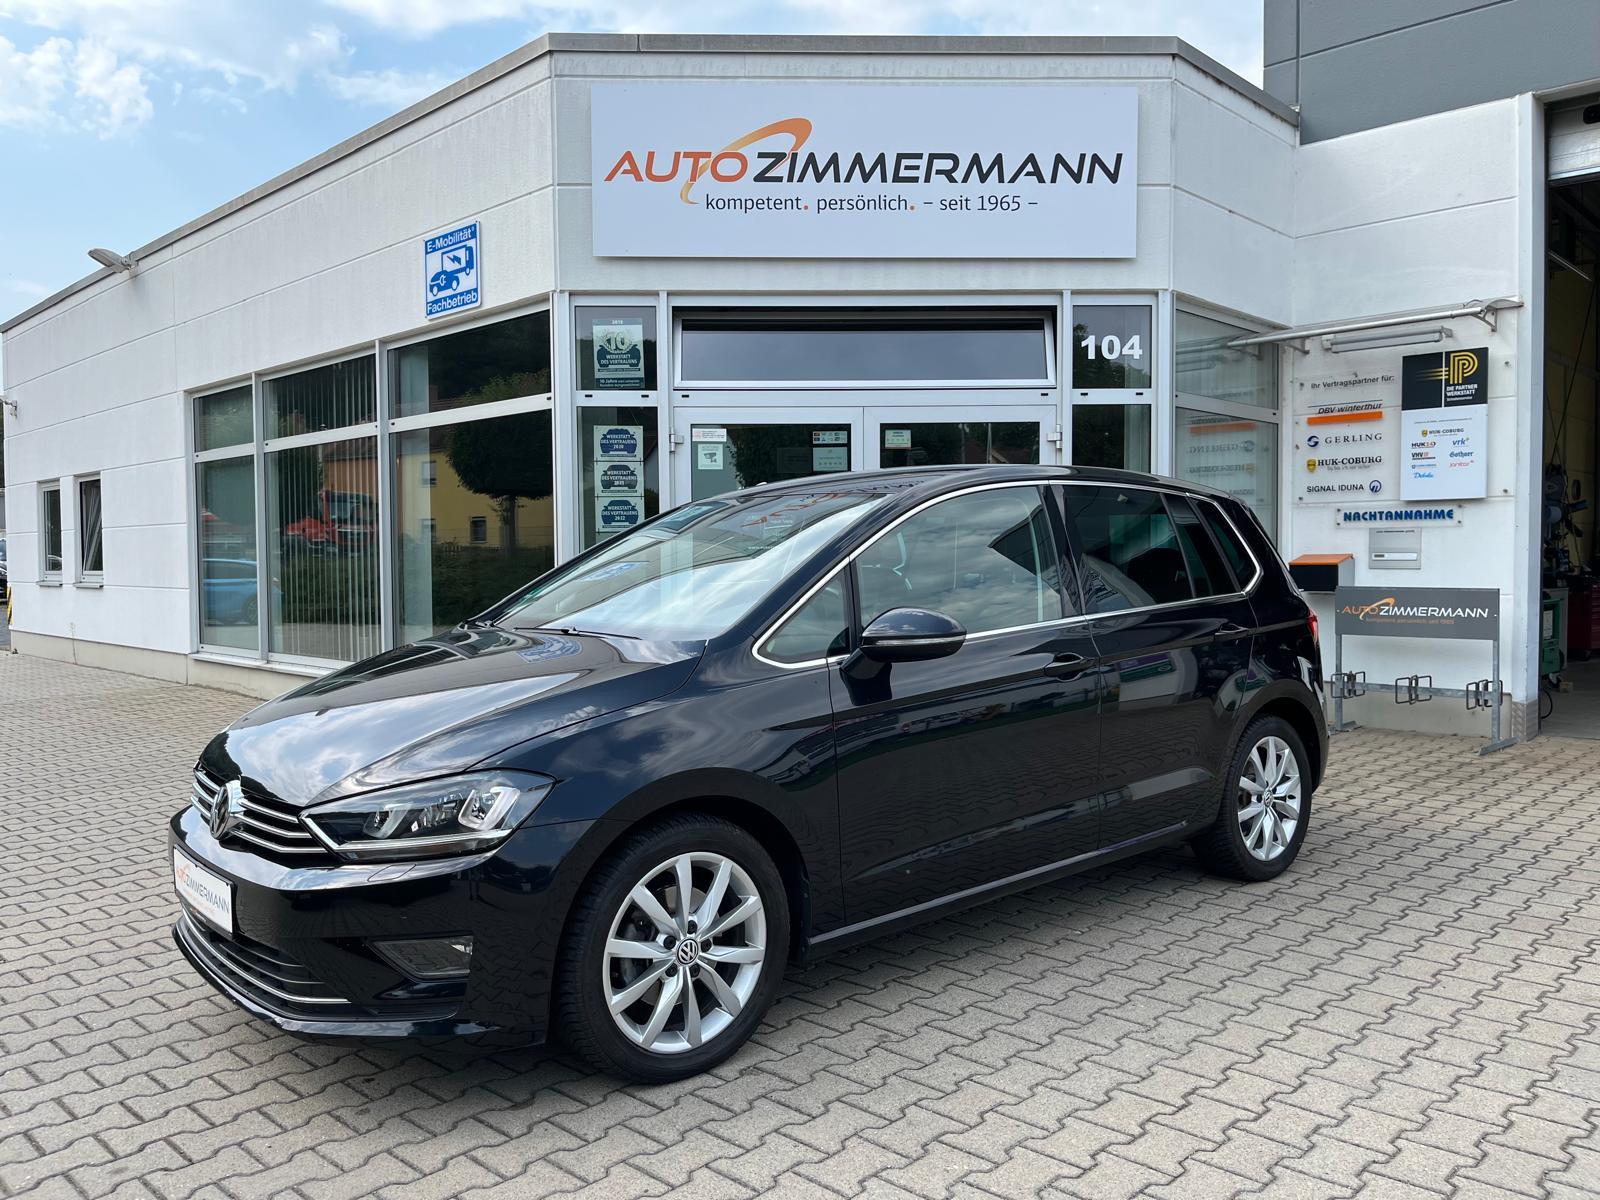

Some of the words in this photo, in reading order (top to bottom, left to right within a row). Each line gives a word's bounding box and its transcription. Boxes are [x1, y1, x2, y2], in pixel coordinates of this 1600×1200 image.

[939, 195, 971, 212] seit
[976, 195, 1022, 212] 1965
[427, 290, 478, 314] Fachbetrieb
[1081, 334, 1143, 360] 104
[1310, 382, 1321, 390] Ihr
[1322, 375, 1379, 389] Vertragspartner
[1318, 406, 1336, 415] DBV
[1324, 432, 1383, 445] GERLING
[1318, 455, 1383, 467] HUK-COBURG
[1306, 484, 1336, 493] SIGNAL
[1338, 484, 1365, 492] IDUNA
[1343, 508, 1454, 522] NACHTANNAHME
